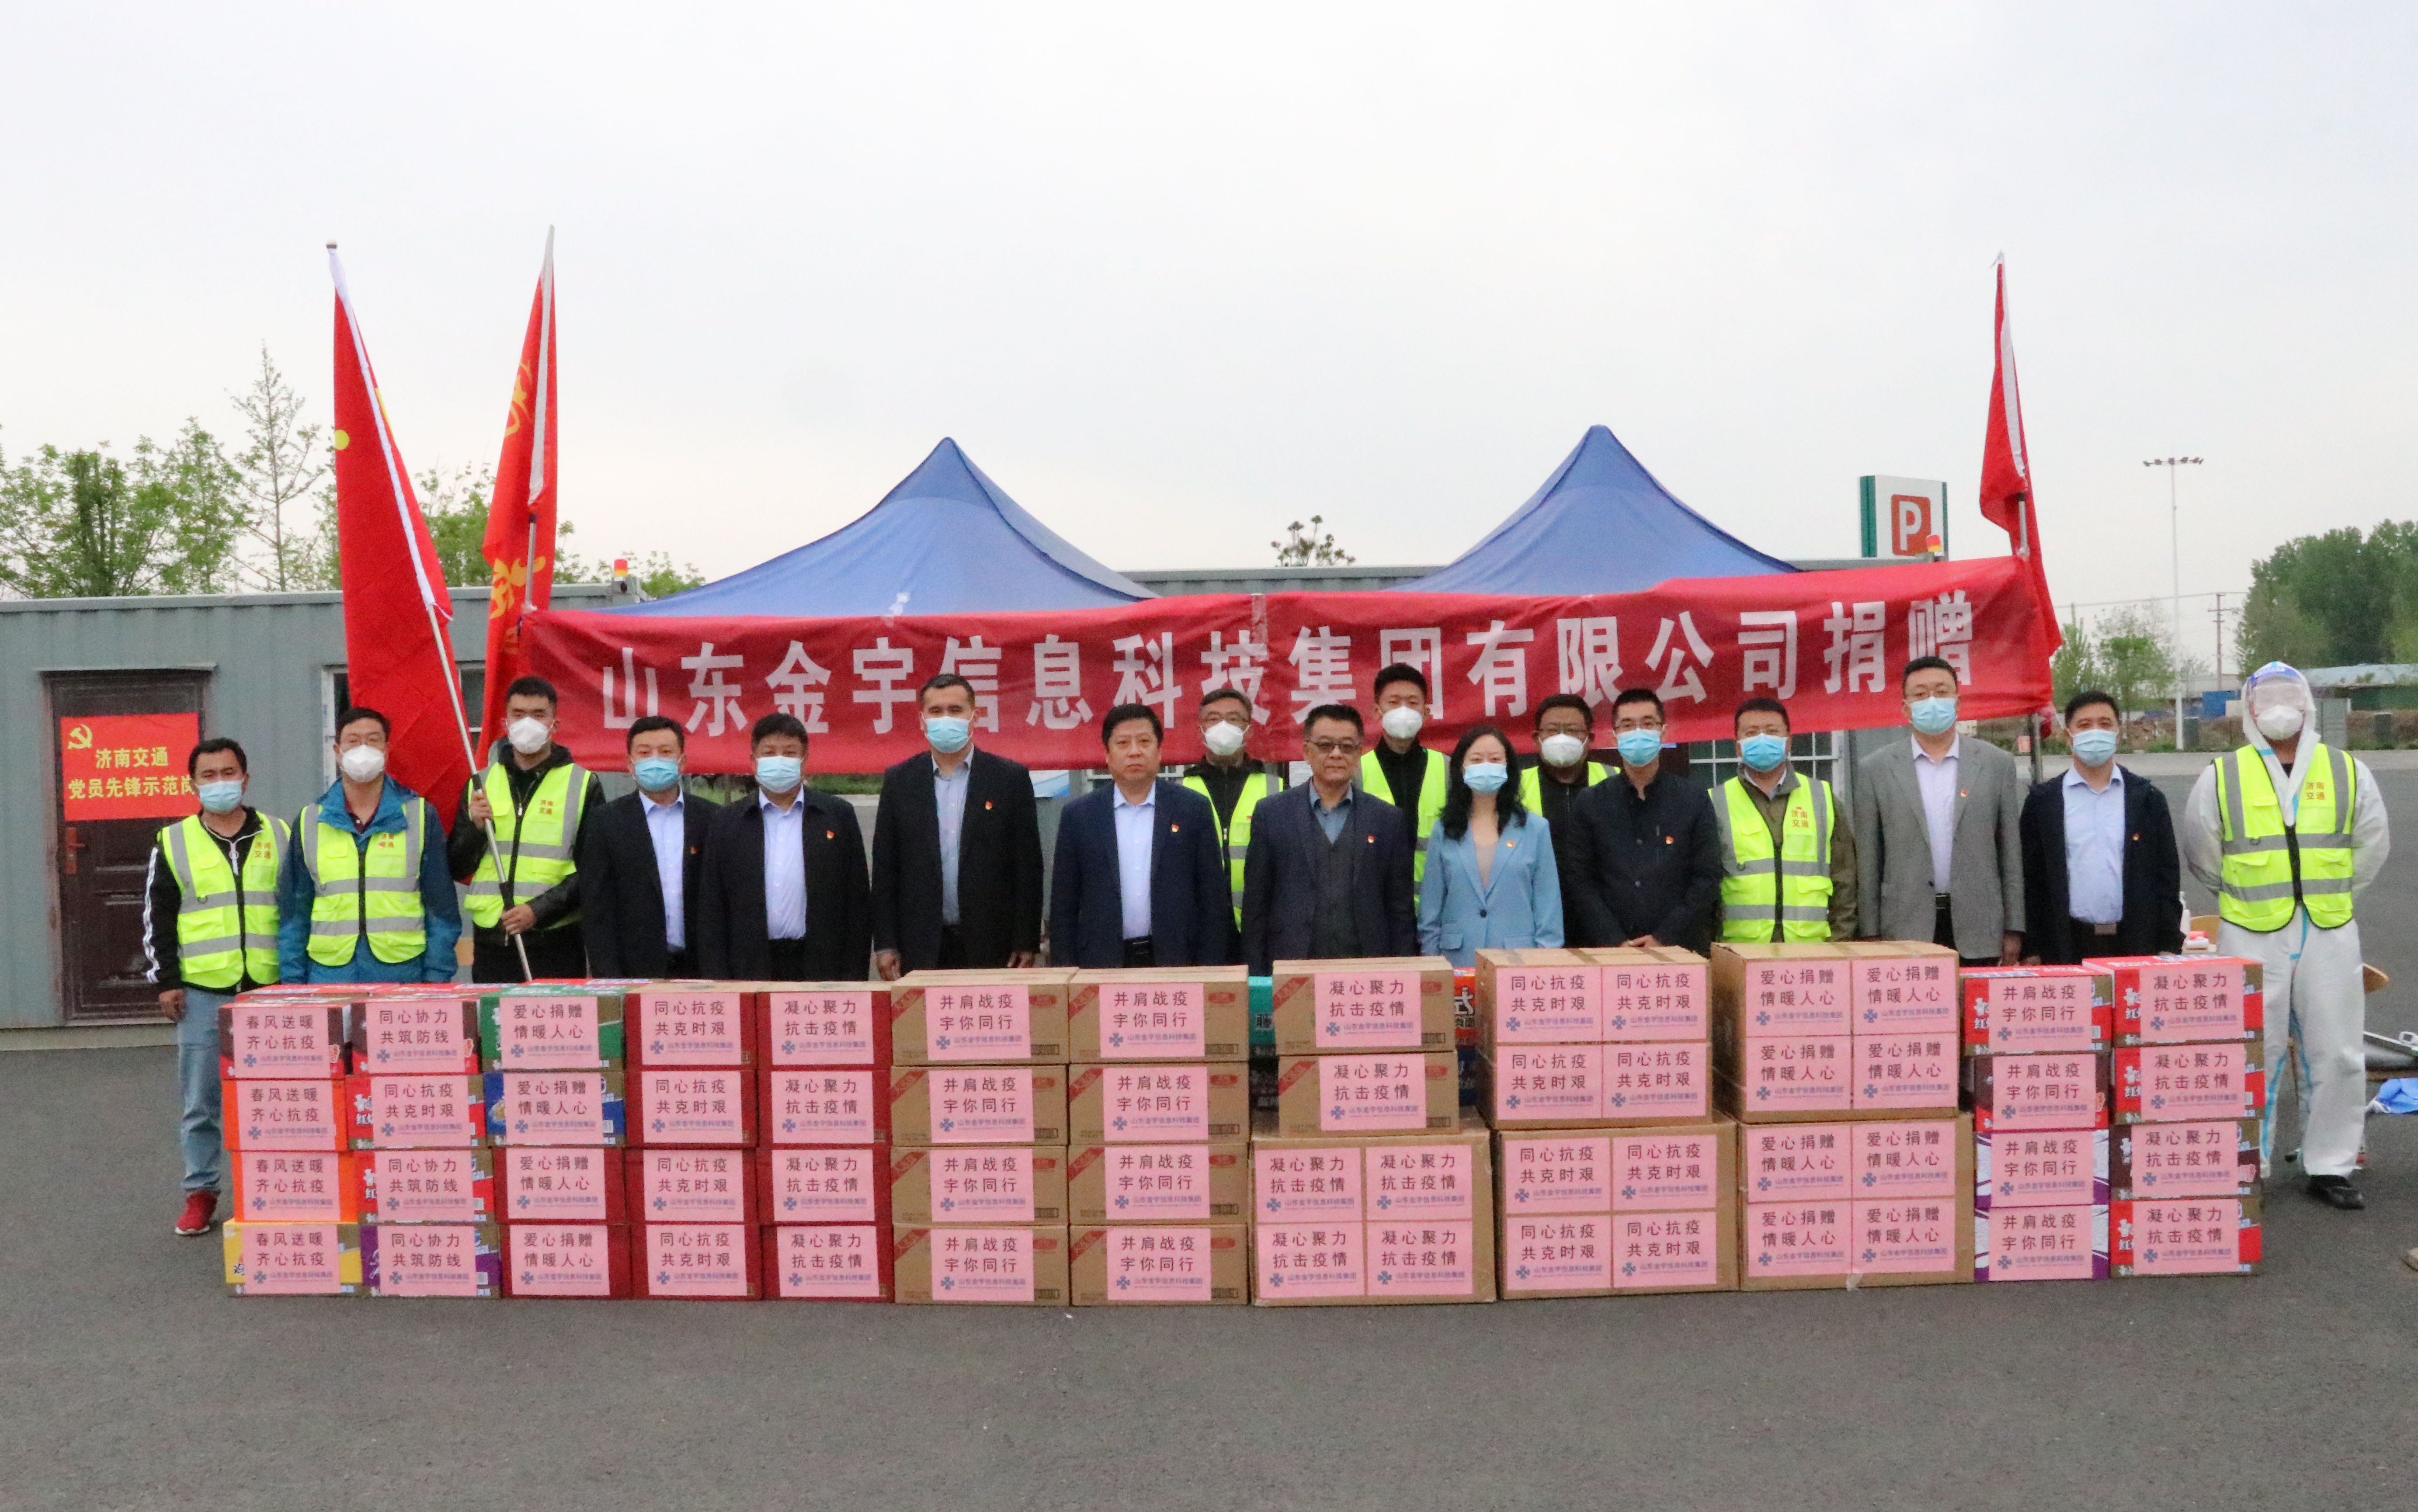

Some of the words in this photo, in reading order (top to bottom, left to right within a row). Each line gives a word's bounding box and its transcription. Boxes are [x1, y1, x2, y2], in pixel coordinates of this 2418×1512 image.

[1899, 501, 1922, 551] P
[603, 590, 1973, 737] 山东金宇信息科技集团有限公司捐赠
[95, 746, 169, 768] 济南交通
[1617, 973, 1690, 989] 同心抗疫
[1761, 969, 1834, 985] 爱心捐赠
[1867, 966, 1939, 983] 爱心捐赠
[2154, 973, 2227, 990] 凝心聚力
[1329, 979, 1404, 995] 凝心聚力
[1511, 974, 1585, 991] 同心抗疫
[1114, 991, 1188, 1006] 并肩战疫
[1760, 991, 1834, 1006] 情暖人心
[1868, 987, 1940, 1003] 情暖人心
[2003, 985, 2075, 1000] 并肩战疫
[655, 1000, 724, 1015] 同心抗疫
[785, 999, 856, 1015] 凝心聚力
[940, 993, 1013, 1009] 并肩战疫
[1511, 996, 1585, 1012] 共克时艰
[1618, 994, 1690, 1010] 共克时艰
[2154, 994, 2227, 1011] 抗击疫情
[379, 1009, 447, 1024] 同心协力
[514, 1004, 582, 1019] 爱心捐赠
[1330, 1001, 1404, 1017] 抗击疫情
[2002, 1006, 2075, 1022] 宇你同行
[247, 1015, 313, 1029] 春风送暖
[940, 1015, 1013, 1031] 宇你同行
[1113, 1012, 1187, 1028] 宇你同行
[514, 1025, 583, 1039] 情暖人心
[655, 1021, 725, 1036] 共克时艰
[785, 1020, 856, 1036] 抗击疫情
[247, 1035, 314, 1049] 齐心抗疫
[381, 1030, 448, 1044] 共筑防线
[1761, 1044, 1834, 1060] 爱心捐赠
[1869, 1042, 1941, 1058] 爱心捐赠
[1512, 1054, 1585, 1069] 同心抗疫
[1618, 1051, 1690, 1067] 同心抗疫
[2155, 1053, 2228, 1068] 凝心聚力
[1334, 1063, 1408, 1079] 凝心聚力
[1761, 1066, 1834, 1081] 情暖人心
[1868, 1063, 1941, 1079] 情暖人心
[2007, 1063, 2080, 1079] 并肩战疫
[656, 1079, 726, 1094] 同心抗疫
[785, 1079, 856, 1093] 凝心聚力
[943, 1077, 1016, 1092] 并肩战疫
[1118, 1075, 1191, 1090] 并肩战疫
[1512, 1075, 1585, 1090] 共克时艰
[1618, 1072, 1689, 1088] 共克时艰
[2155, 1073, 2229, 1090] 抗击疫情
[251, 1088, 318, 1102] 春风送暖
[385, 1083, 453, 1098] 同心抗疫
[518, 1081, 586, 1095] 爱心捐赠
[1335, 1084, 1409, 1100] 抗击疫情
[2007, 1084, 2079, 1100] 宇你同行
[386, 1103, 454, 1118] 共克时艰
[518, 1101, 587, 1115] 情暖人心
[657, 1100, 726, 1114] 共克时艰
[786, 1099, 857, 1114] 抗击疫情
[944, 1098, 1016, 1113] 宇你同行
[1117, 1096, 1190, 1112] 宇你同行
[252, 1108, 318, 1122] 齐心抗疫
[1761, 1134, 1834, 1151] 爱心捐赠
[1867, 1131, 1939, 1147] 爱心捐赠
[2146, 1130, 2220, 1145] 凝心聚力
[1520, 1146, 1593, 1162] 同心抗疫
[1628, 1143, 1700, 1159] 同心抗疫
[2005, 1139, 2077, 1155] 并肩战疫
[257, 1159, 323, 1173] 春风送暖
[389, 1159, 456, 1172] 同心协力
[520, 1156, 588, 1170] 爱心捐赠
[658, 1158, 726, 1172] 同心抗疫
[786, 1157, 857, 1171] 凝心聚力
[944, 1157, 1017, 1172] 并肩战疫
[1119, 1154, 1192, 1169] 并肩战疫
[1270, 1156, 1344, 1172] 凝心聚力
[1380, 1154, 1455, 1169] 凝心聚力
[1761, 1155, 1834, 1172] 情暖人心
[1867, 1152, 1939, 1167] 情暖人心
[2146, 1150, 2221, 1167] 抗击疫情
[1521, 1167, 1593, 1183] 共克时艰
[1627, 1165, 1700, 1180] 共克时艰
[2005, 1161, 2076, 1177] 宇你同行
[257, 1179, 323, 1193] 齐心抗疫
[390, 1179, 458, 1192] 共筑防线
[520, 1176, 589, 1190] 情暖人心
[659, 1178, 727, 1193] 共克时艰
[787, 1177, 858, 1192] 抗击疫情
[944, 1178, 1016, 1193] 宇你同行
[1119, 1175, 1192, 1190] 宇你同行
[1271, 1177, 1344, 1193] 抗击疫情
[1381, 1174, 1455, 1190] 抗击疫情
[1762, 1210, 1835, 1227] 爱心捐赠
[1867, 1207, 1939, 1223] 爱心捐赠
[2003, 1214, 2076, 1229] 并肩战疫
[2147, 1207, 2221, 1223] 凝心聚力
[1521, 1223, 1595, 1239] 同心抗疫
[1627, 1220, 1700, 1236] 同心抗疫
[1866, 1228, 1939, 1243] 情暖人心
[256, 1232, 323, 1246] 春风送暖
[392, 1233, 459, 1247] 同心协力
[524, 1233, 592, 1247] 爱心捐赠
[660, 1232, 729, 1246] 同心抗疫
[791, 1234, 861, 1248] 凝心聚力
[1122, 1236, 1194, 1251] 并肩战疫
[1272, 1231, 1346, 1247] 凝心聚力
[1382, 1230, 1456, 1245] 凝心聚力
[1762, 1231, 1835, 1247] 情暖人心
[2002, 1235, 2075, 1251] 宇你同行
[2147, 1228, 2222, 1244] 抗击疫情
[945, 1237, 1017, 1252] 并肩战疫
[1627, 1241, 1700, 1257] 共克时艰
[257, 1252, 324, 1266] 齐心抗疫
[393, 1253, 461, 1267] 共筑防线
[524, 1253, 593, 1267] 情暖人心
[662, 1252, 730, 1266] 共克时艰
[1382, 1251, 1456, 1266] 抗击疫情
[1522, 1245, 1595, 1260] 共克时艰
[792, 1254, 862, 1268] 抗击疫情
[945, 1258, 1017, 1273] 宇你同行
[1121, 1257, 1194, 1272] 宇你同行
[1273, 1252, 1347, 1269] 抗击疫情
